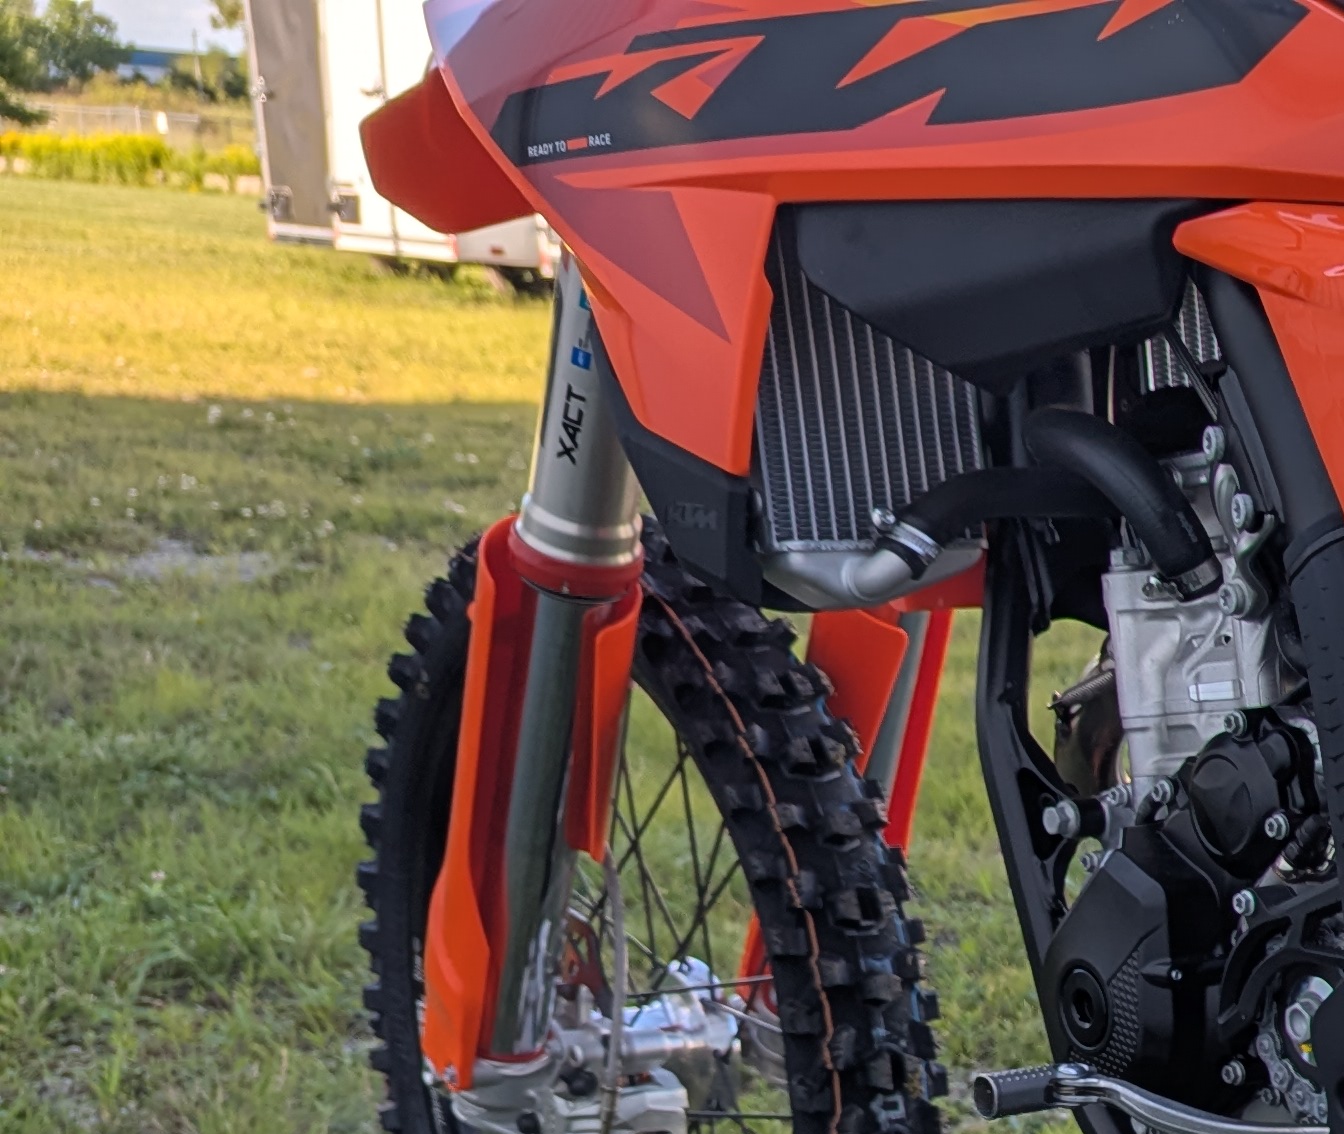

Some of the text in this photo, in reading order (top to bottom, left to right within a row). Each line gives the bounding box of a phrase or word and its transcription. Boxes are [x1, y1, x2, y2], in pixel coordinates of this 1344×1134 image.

[527, 133, 612, 157] READY TO RACE
[556, 383, 587, 466] XACT
